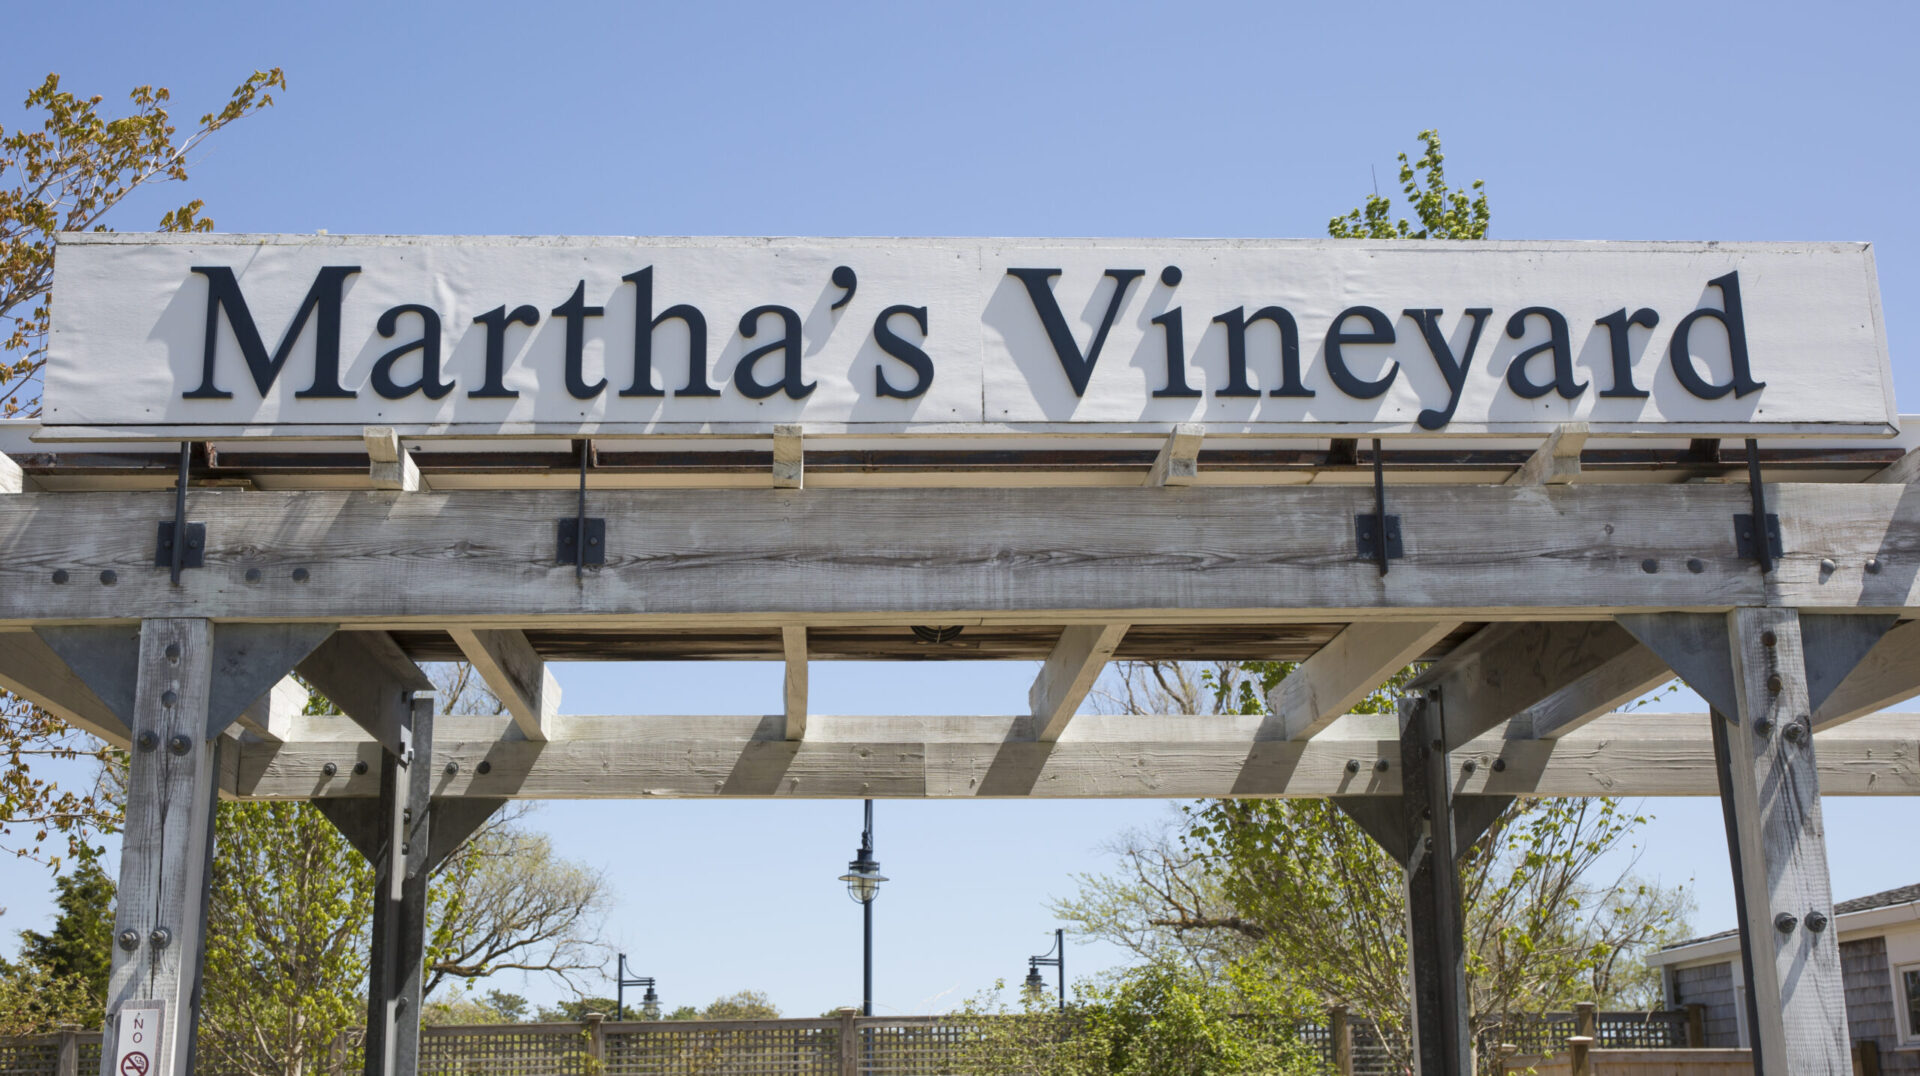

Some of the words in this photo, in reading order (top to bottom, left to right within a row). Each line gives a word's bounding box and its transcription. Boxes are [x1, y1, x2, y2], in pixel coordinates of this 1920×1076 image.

[182, 265, 934, 400] Martha's
[1006, 265, 1766, 430] Vineyard
[132, 1018, 144, 1044] NO
